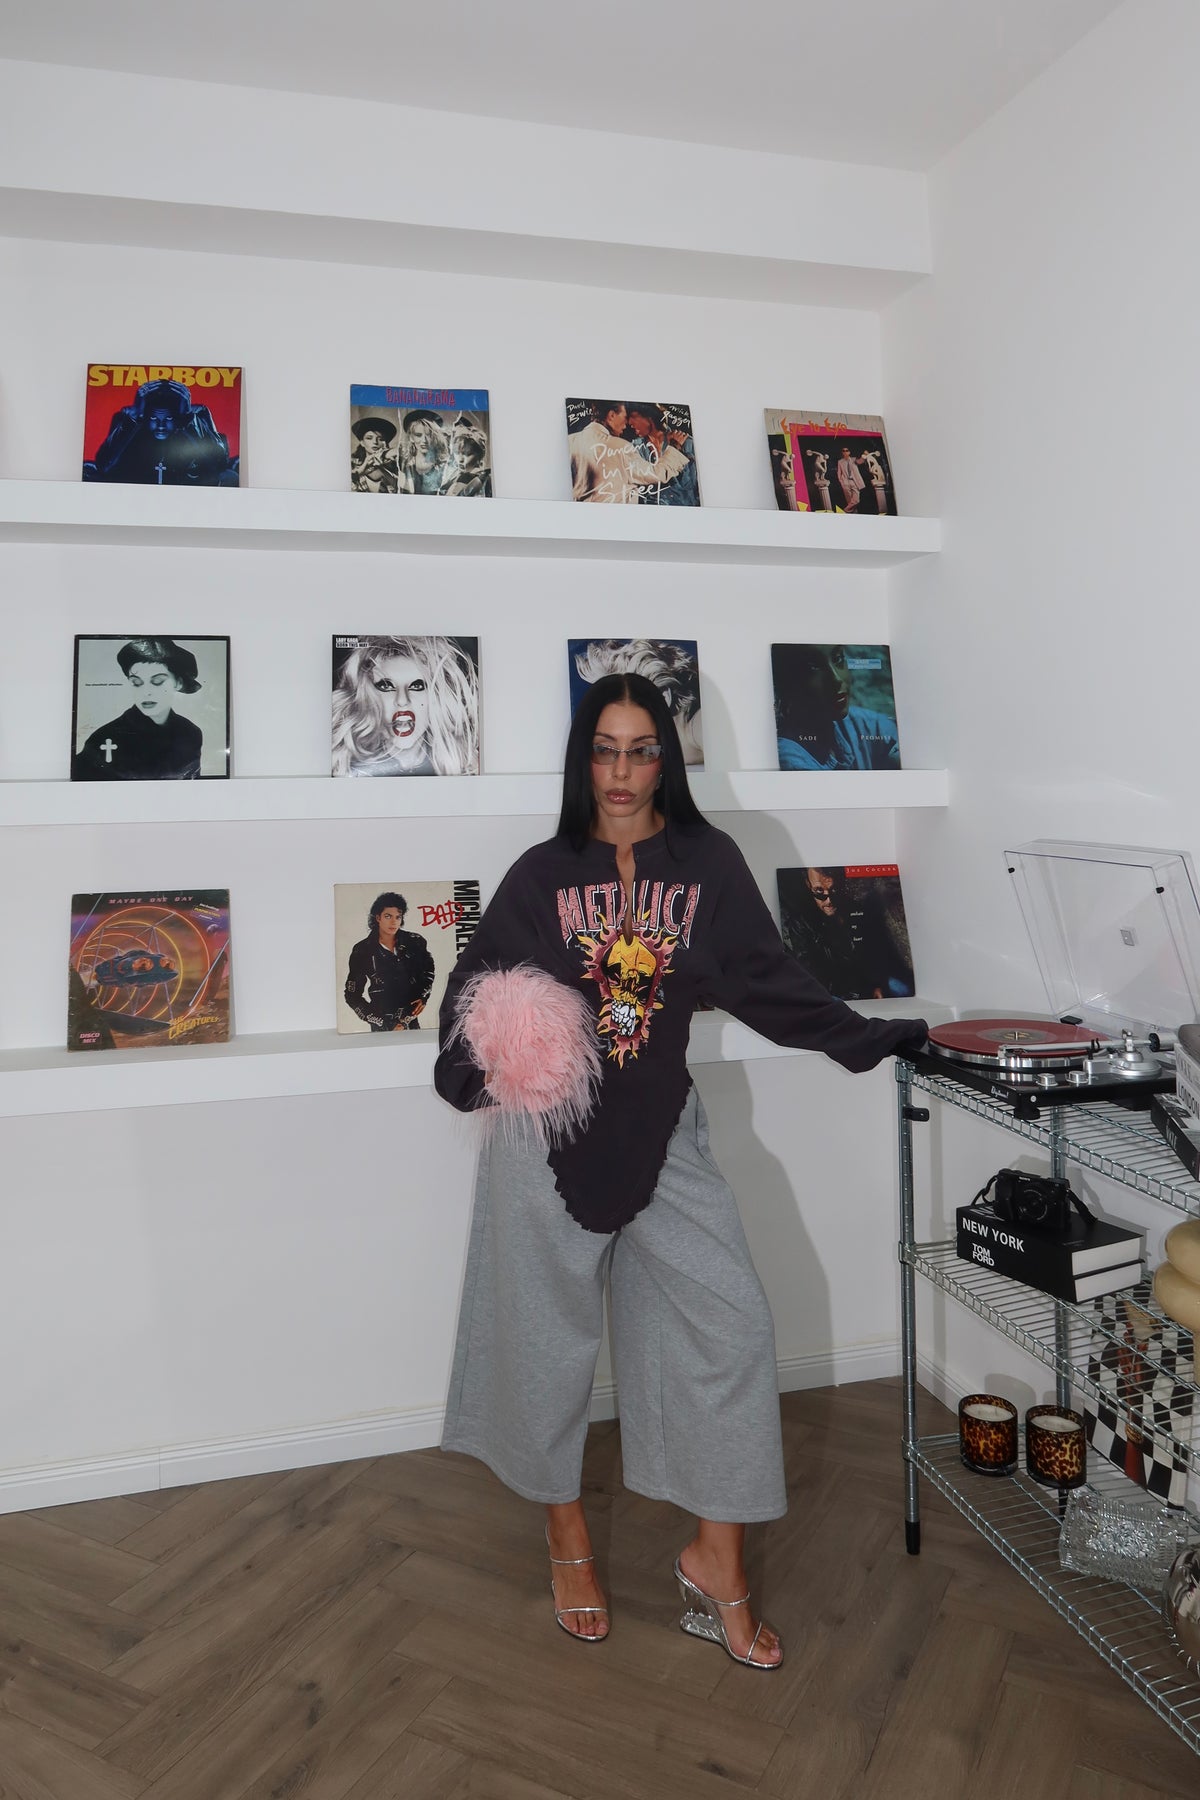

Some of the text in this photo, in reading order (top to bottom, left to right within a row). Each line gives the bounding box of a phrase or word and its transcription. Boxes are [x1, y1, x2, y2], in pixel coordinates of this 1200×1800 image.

[88, 365, 240, 387] STARBOY
[386, 386, 456, 407] BANANARAMA
[590, 441, 659, 466] Dancing
[602, 464, 621, 479] in
[417, 900, 464, 930] BAD
[962, 1217, 1025, 1253] NEW YORK
[972, 1242, 991, 1258] TOM
[972, 1250, 995, 1266] FORD
